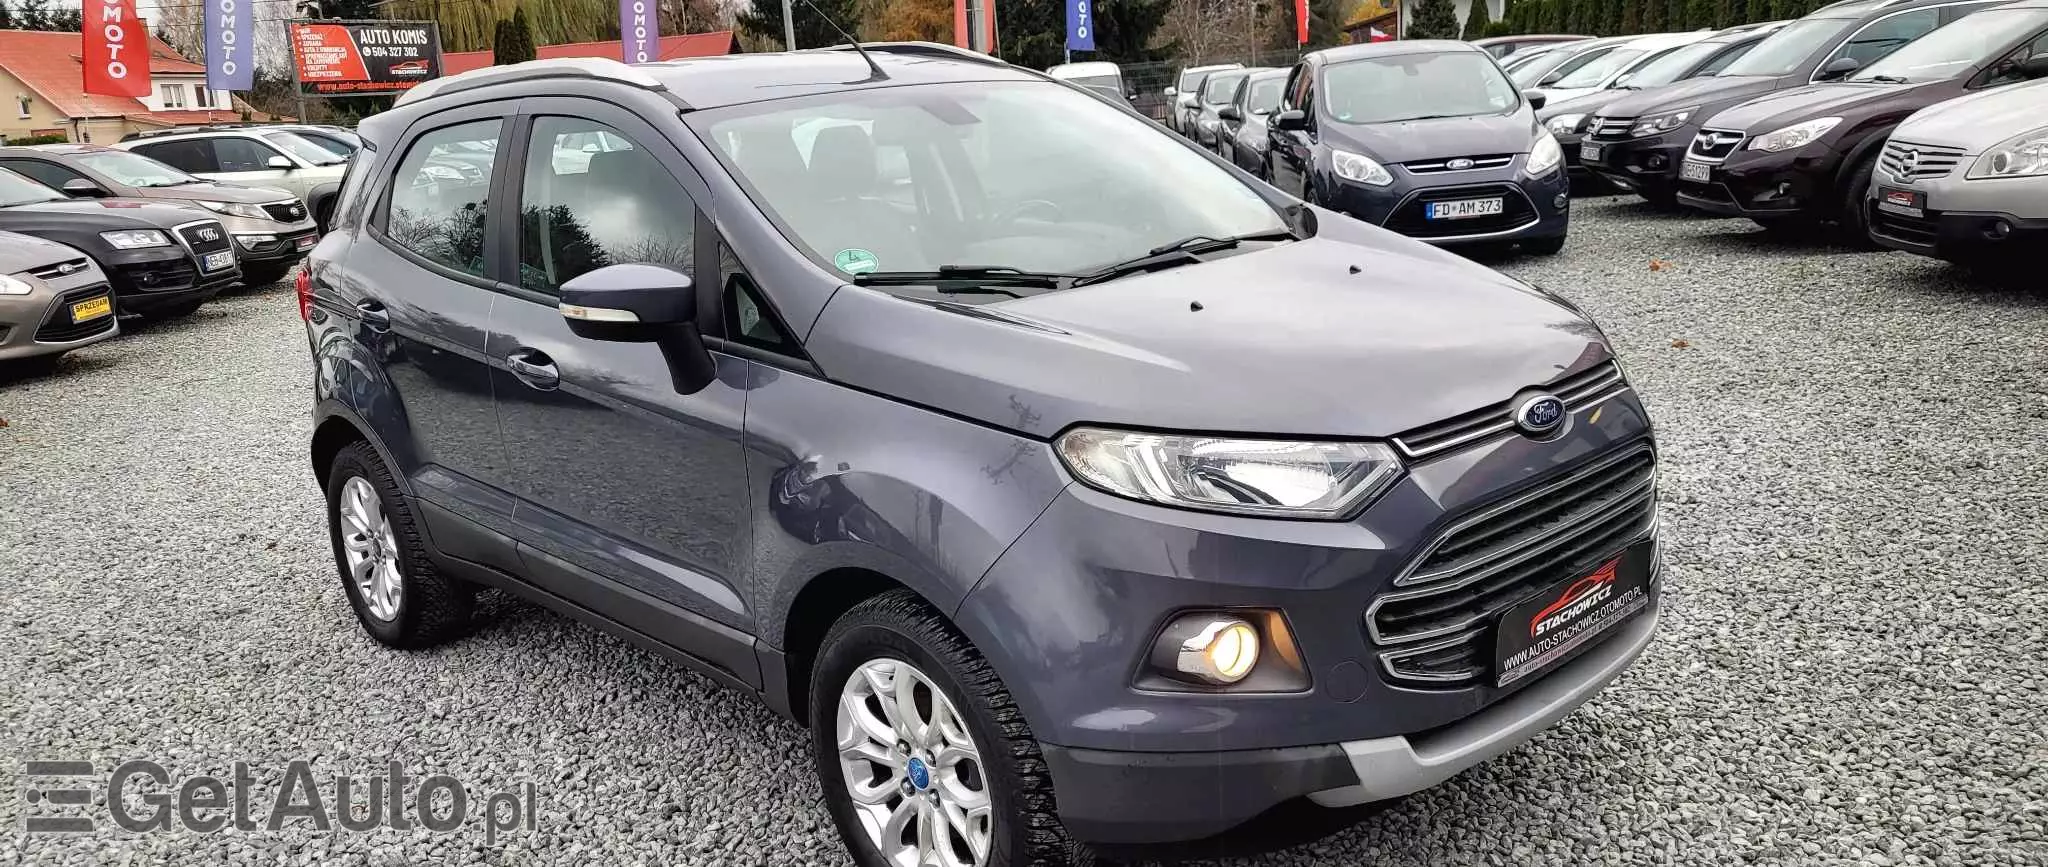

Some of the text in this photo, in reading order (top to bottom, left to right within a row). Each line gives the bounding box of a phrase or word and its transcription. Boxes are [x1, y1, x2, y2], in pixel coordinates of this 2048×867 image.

[103, 0, 127, 79] MOTO
[360, 29, 428, 45] AUTO KOMIS
[633, 1, 648, 63] OMOTO
[372, 46, 419, 57] 504 327 302
[1478, 200, 1501, 213] 373
[1533, 401, 1558, 424] Ford
[1503, 585, 1642, 671] WWW.AUTO-STACHOWICZ.OTOMOTO.PL
[1535, 584, 1613, 637] STACHOWICZ
